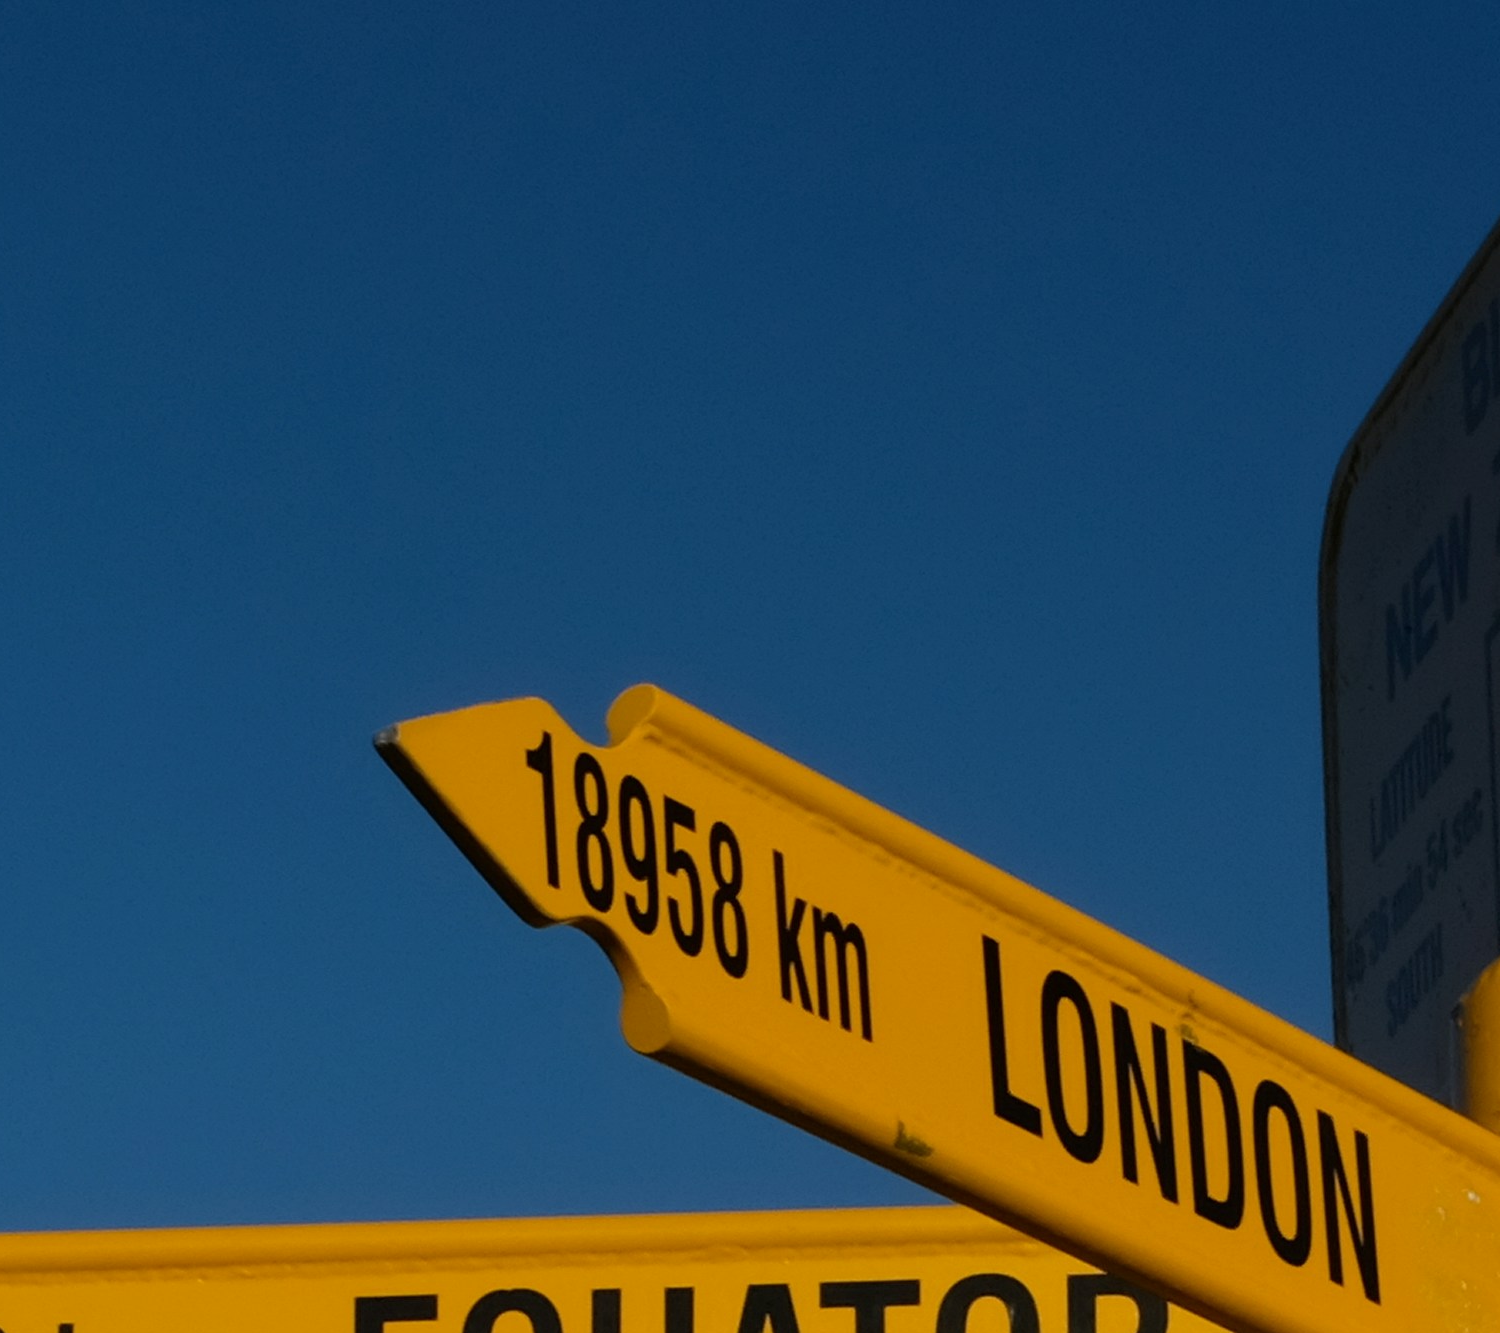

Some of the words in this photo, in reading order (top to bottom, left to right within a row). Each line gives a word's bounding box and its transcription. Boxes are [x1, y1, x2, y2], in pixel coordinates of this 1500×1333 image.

[1385, 494, 1472, 701] NEW
[1369, 694, 1455, 863] LATITUDE
[524, 730, 750, 980] 18958
[773, 850, 875, 1043] km
[980, 934, 1383, 1305] LONDON
[1386, 921, 1444, 1038] SOUTH
